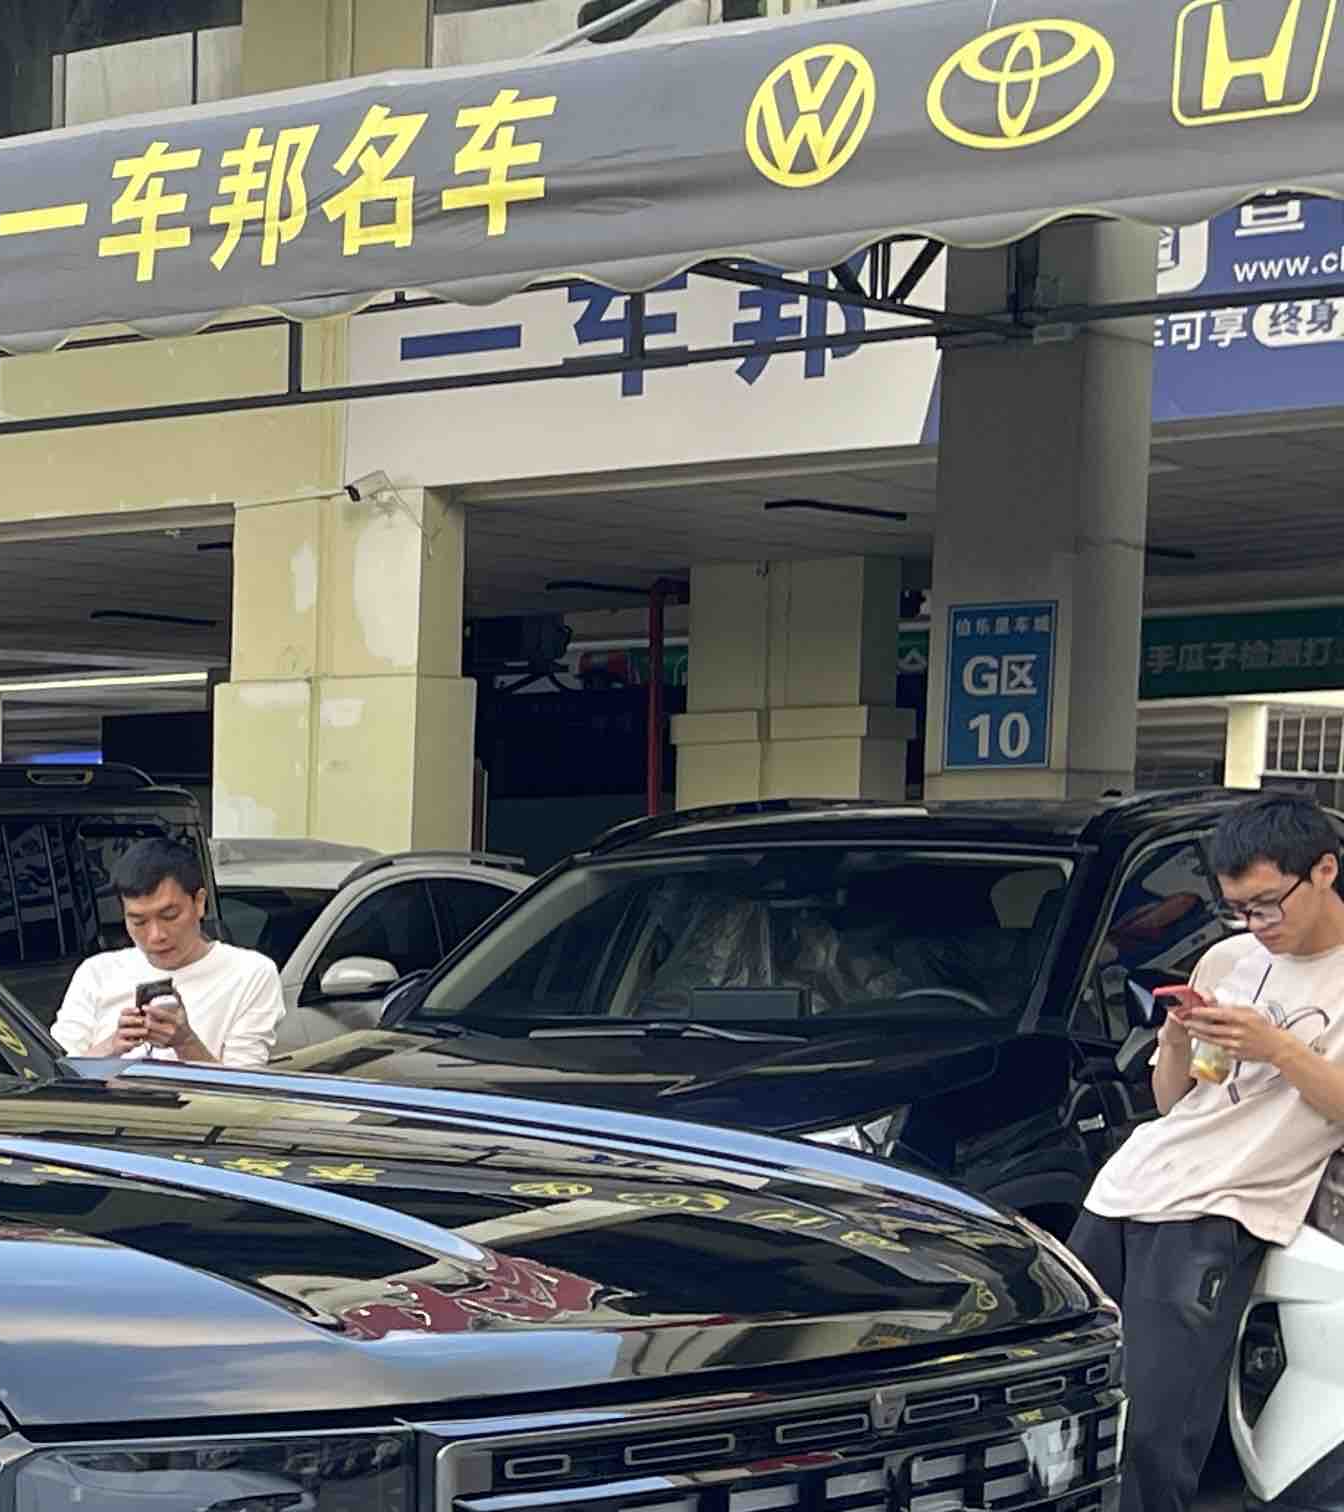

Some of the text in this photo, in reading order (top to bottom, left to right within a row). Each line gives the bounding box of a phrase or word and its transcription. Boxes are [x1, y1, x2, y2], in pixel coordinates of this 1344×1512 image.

[1153, 307, 1248, 351] 可享
[962, 654, 1037, 697] G区
[968, 712, 1031, 759] 10
